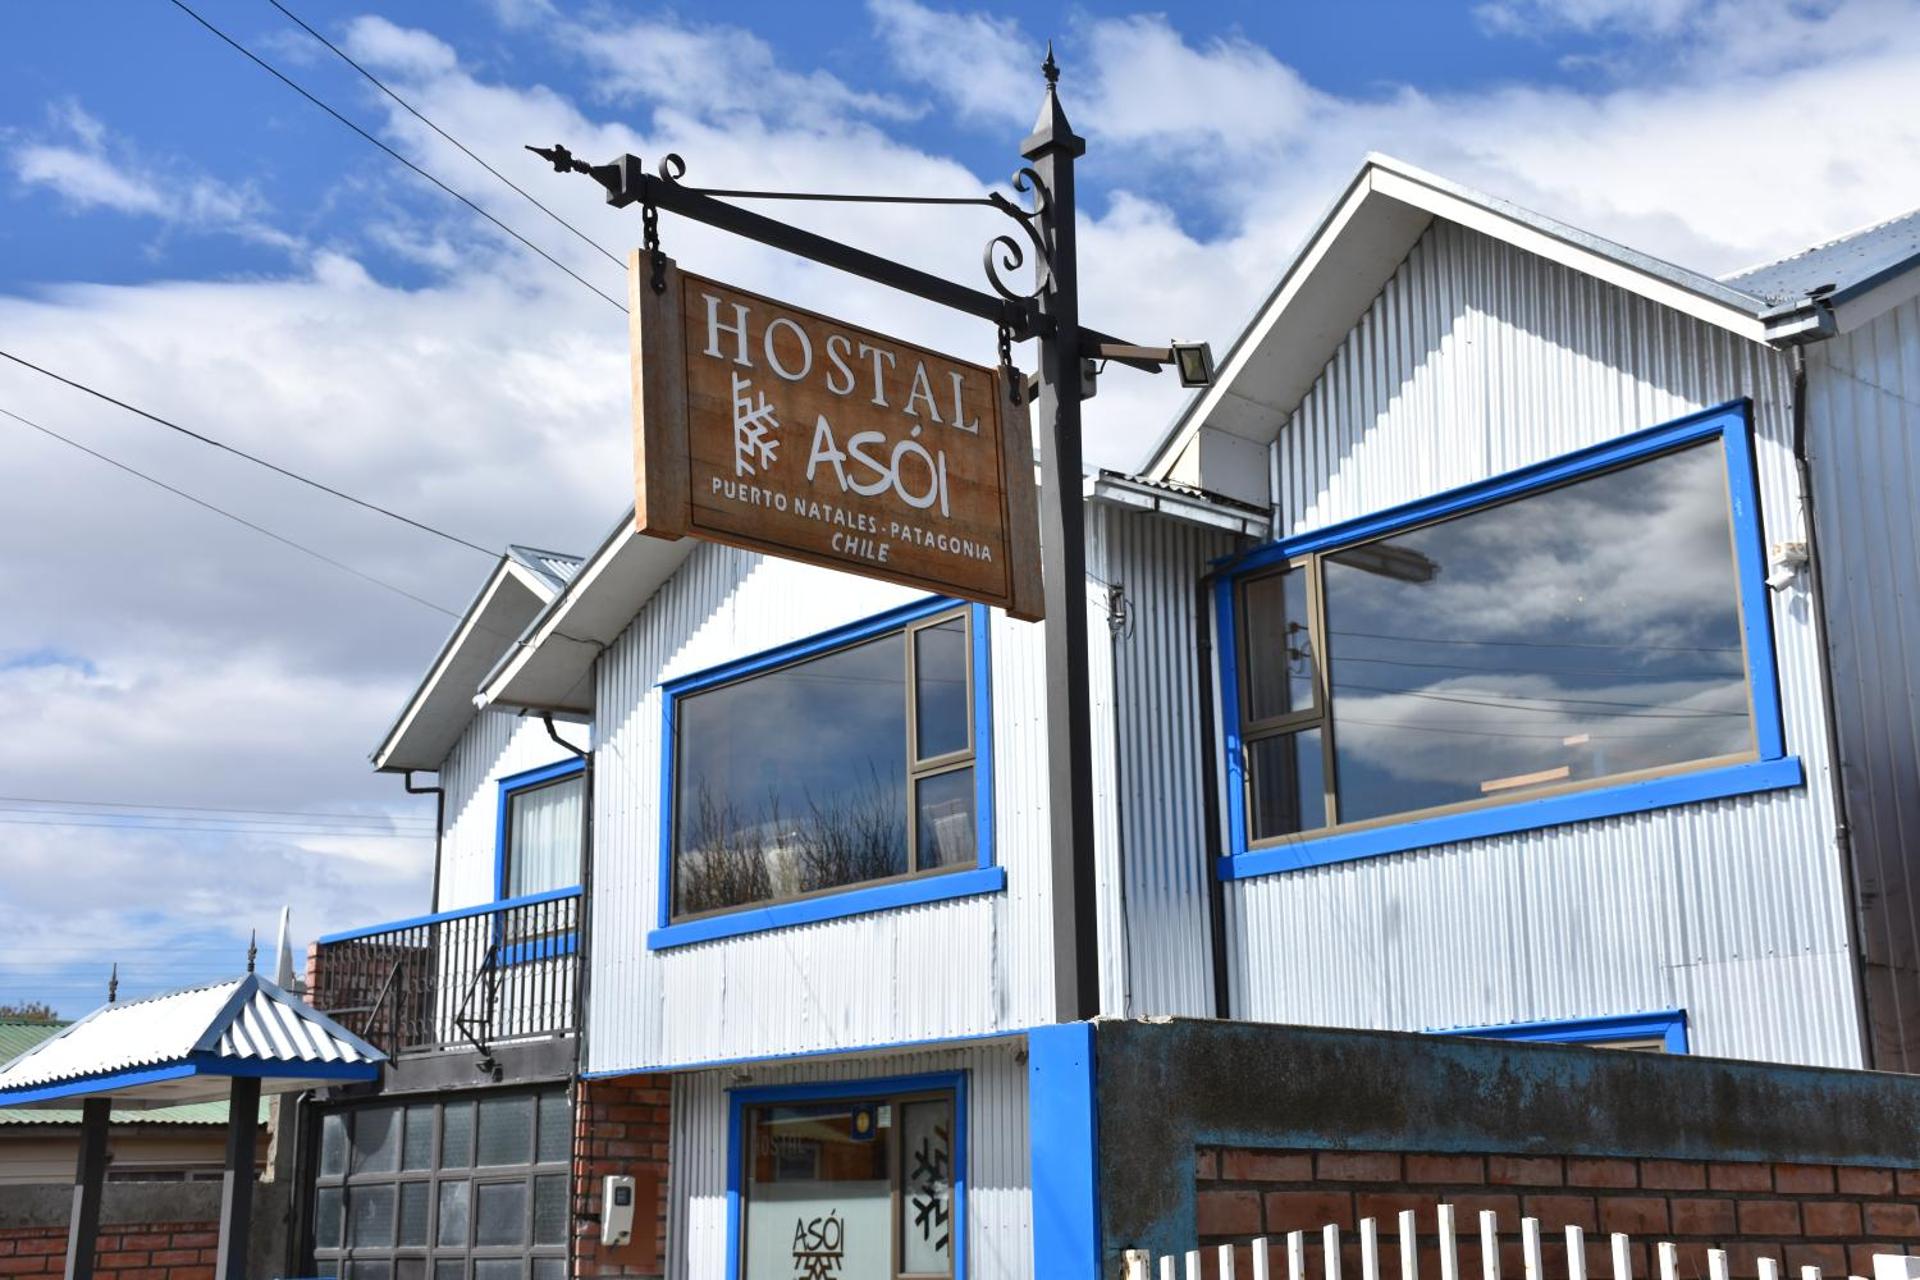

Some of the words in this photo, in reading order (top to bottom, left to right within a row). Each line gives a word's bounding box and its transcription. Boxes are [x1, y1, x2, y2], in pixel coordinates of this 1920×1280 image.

[702, 293, 979, 434] HOSTAL
[806, 414, 949, 518] ASÓI
[712, 477, 787, 512] PUERTO
[794, 497, 877, 534] NATALES
[891, 521, 992, 562] PATAGONIA
[832, 532, 889, 563] CHILE
[792, 1208, 844, 1251] ASÓI
